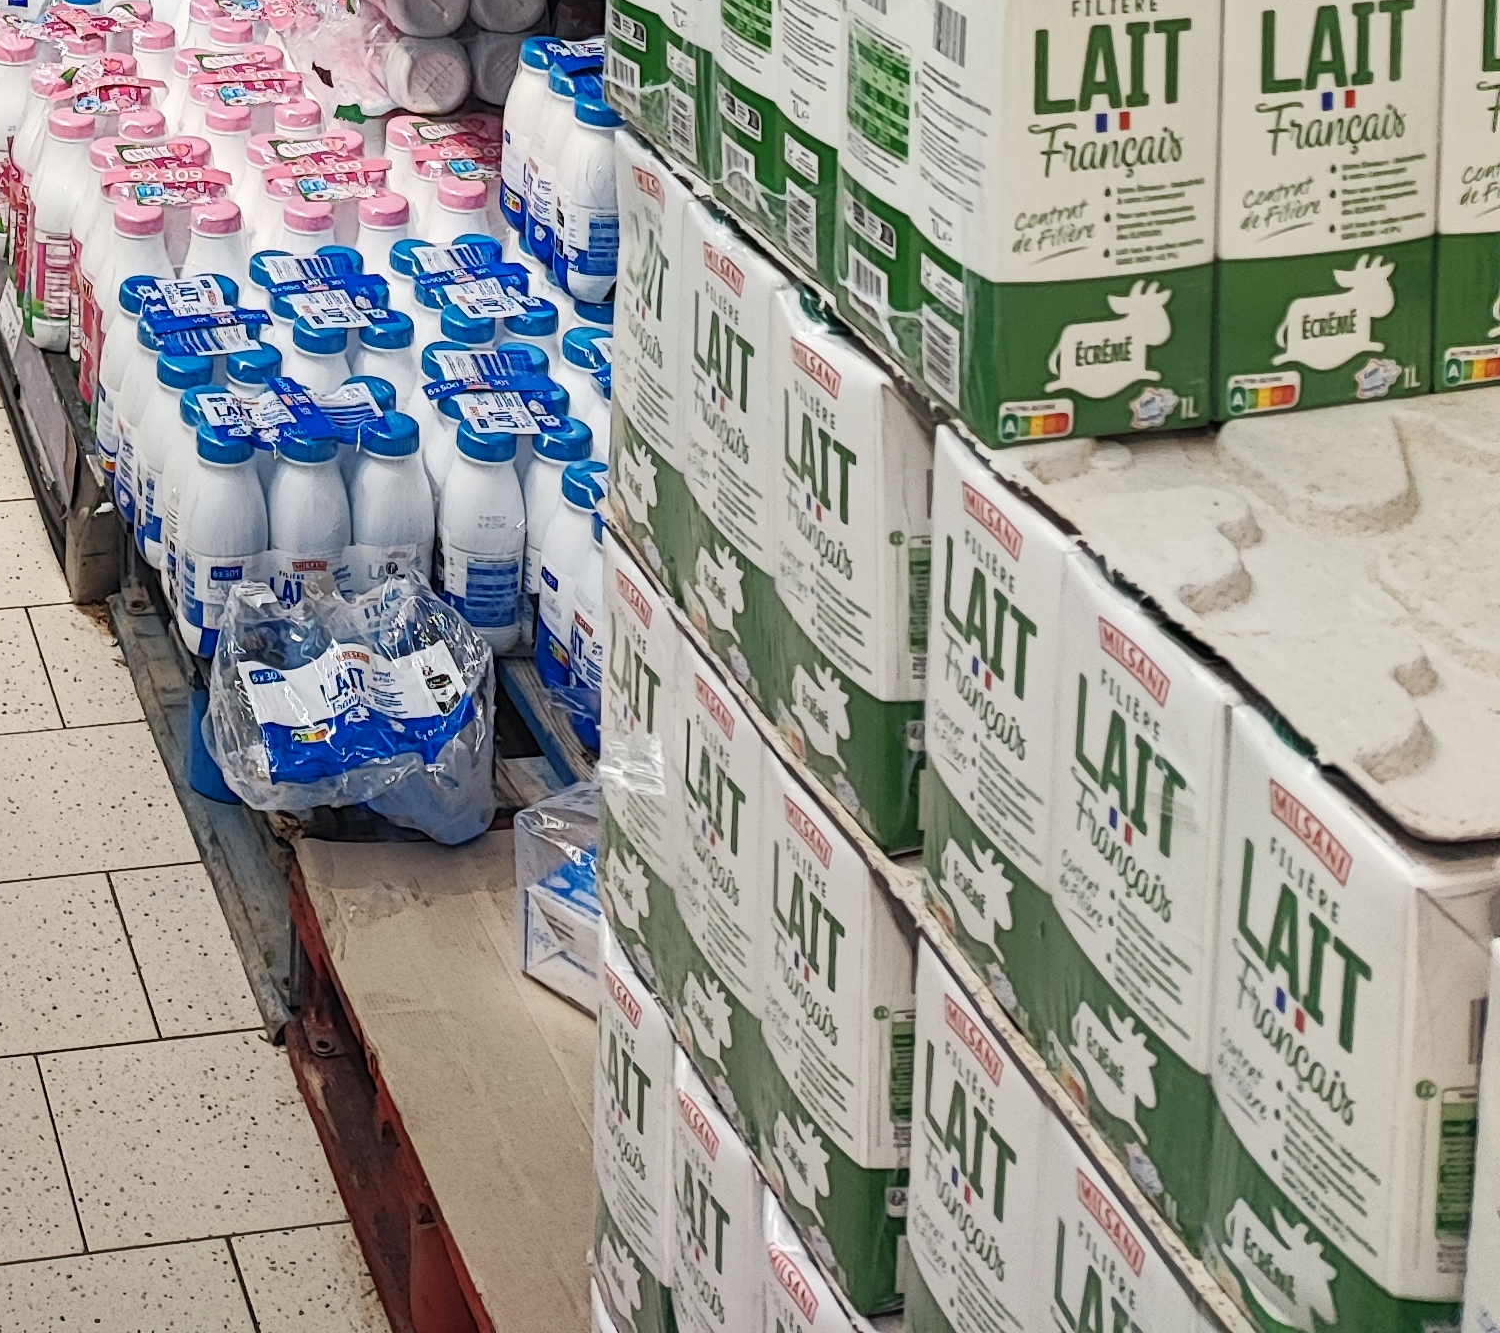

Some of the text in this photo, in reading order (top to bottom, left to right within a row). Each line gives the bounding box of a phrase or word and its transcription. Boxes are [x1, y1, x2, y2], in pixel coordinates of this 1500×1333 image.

[1034, 18, 1192, 115] LAIT
[1028, 123, 1184, 179] Français
[1255, 101, 1407, 156] Français
[1014, 198, 1089, 232] Contrat
[1240, 199, 1321, 231] de Filière
[1243, 176, 1315, 209] Contrat
[706, 248, 743, 293] MILSANI
[1012, 223, 1096, 254] de Filière
[694, 290, 754, 413] LAIT
[1075, 336, 1133, 367] ÉCRÉMÉ
[1302, 308, 1357, 340] ÉCRÉMÉ
[795, 343, 839, 395] MILSANI
[795, 380, 836, 431] FILIÈRE
[1181, 396, 1199, 419] 1L
[1403, 367, 1421, 389] 1L
[692, 365, 750, 465] Français
[784, 387, 857, 525] LAIT
[781, 468, 853, 581] Français
[964, 484, 1021, 558] MILSANI
[964, 530, 1016, 595] FILIÈRE
[945, 535, 1037, 701] LAIT
[940, 622, 1028, 761] Français
[1100, 619, 1169, 705] MILSANI
[1100, 669, 1160, 741] FILIÈRE
[685, 717, 746, 857] LAIT
[1076, 673, 1187, 857] LAIT
[786, 795, 832, 869] MILSANI
[1071, 766, 1172, 923] Français
[1268, 781, 1352, 884] MILSANI
[773, 840, 845, 994] LAIT
[1270, 837, 1341, 925] FILIÈRE
[770, 916, 840, 1047] Français
[1238, 837, 1372, 1053] LAIT
[946, 999, 1004, 1084] MILSANI
[1233, 938, 1356, 1126] Français
[945, 1042, 995, 1116] FILIÈRE
[926, 1040, 1017, 1223] LAIT
[921, 1121, 1006, 1283] Français
[1079, 1172, 1146, 1273] MILSANI
[1077, 1220, 1136, 1312] FILIÈRE
